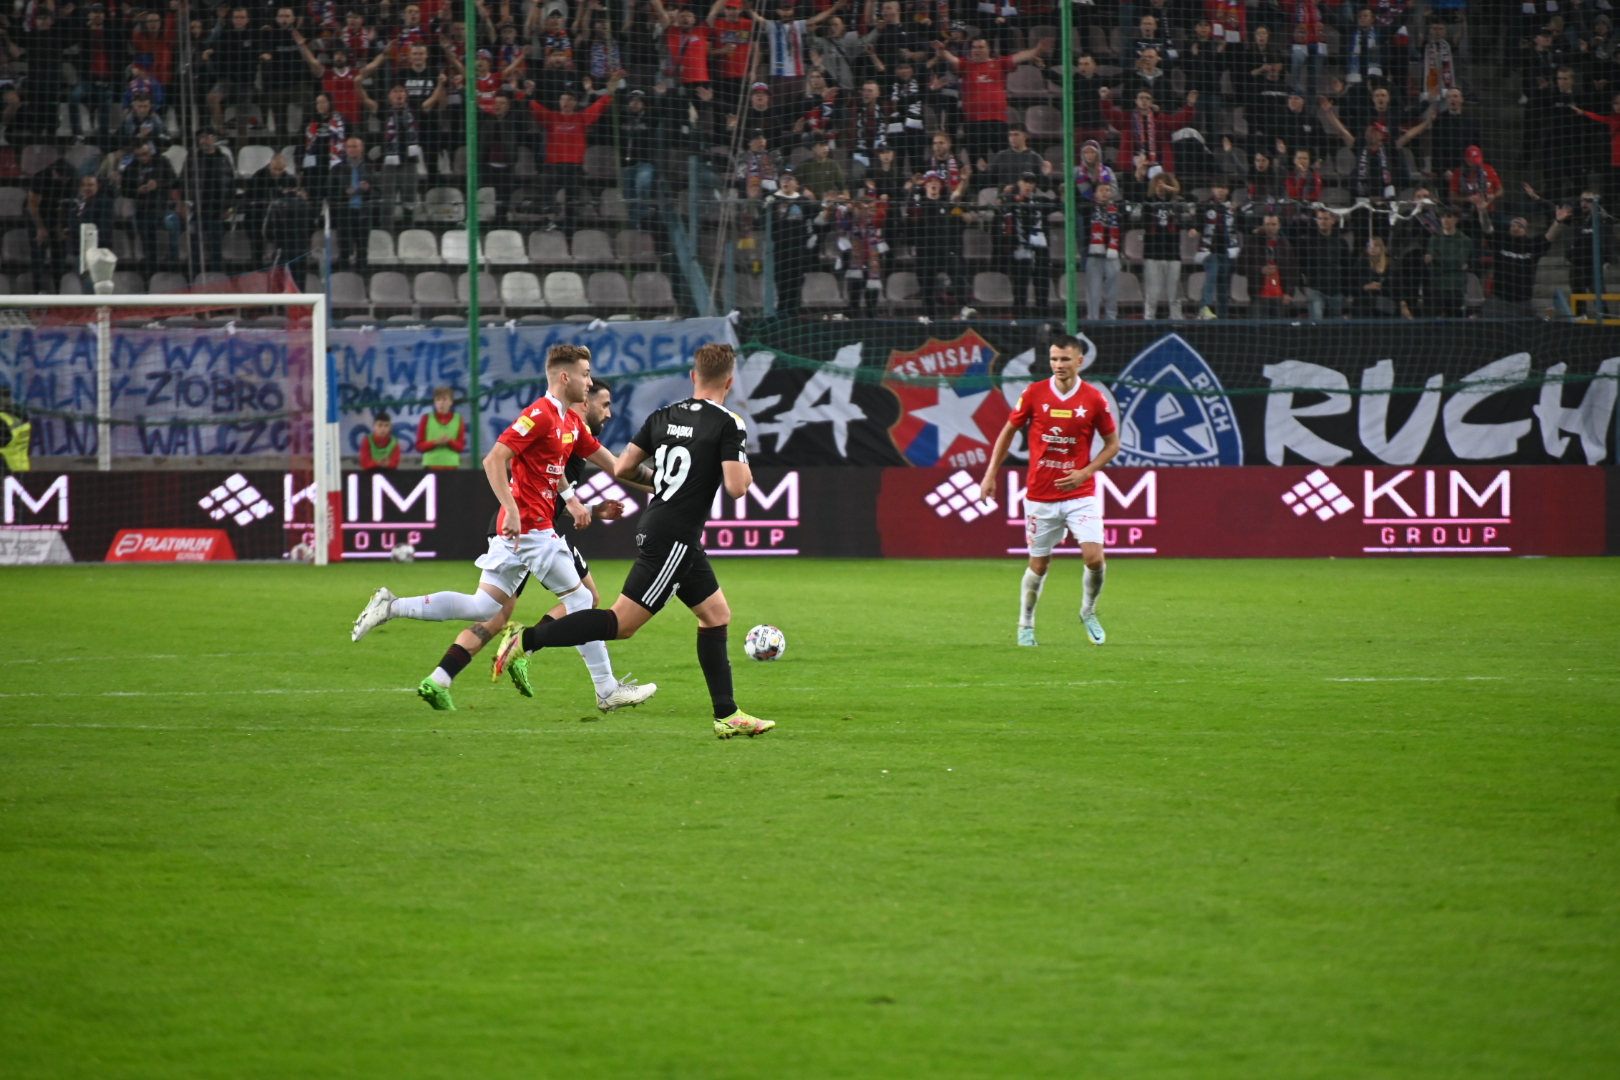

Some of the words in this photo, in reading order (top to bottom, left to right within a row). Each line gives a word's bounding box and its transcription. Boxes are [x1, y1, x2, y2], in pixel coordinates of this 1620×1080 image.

[893, 361, 920, 381] TS
[920, 345, 983, 373] WISŁA
[1263, 352, 1620, 466] RUCH
[667, 424, 693, 438] TRĄBKA
[654, 444, 692, 502] 19
[948, 447, 988, 468] 1906
[283, 473, 437, 523] KIM
[1363, 469, 1511, 518] KIM
[141, 536, 213, 552] PLATINUM
[1381, 527, 1498, 545] GROUP
